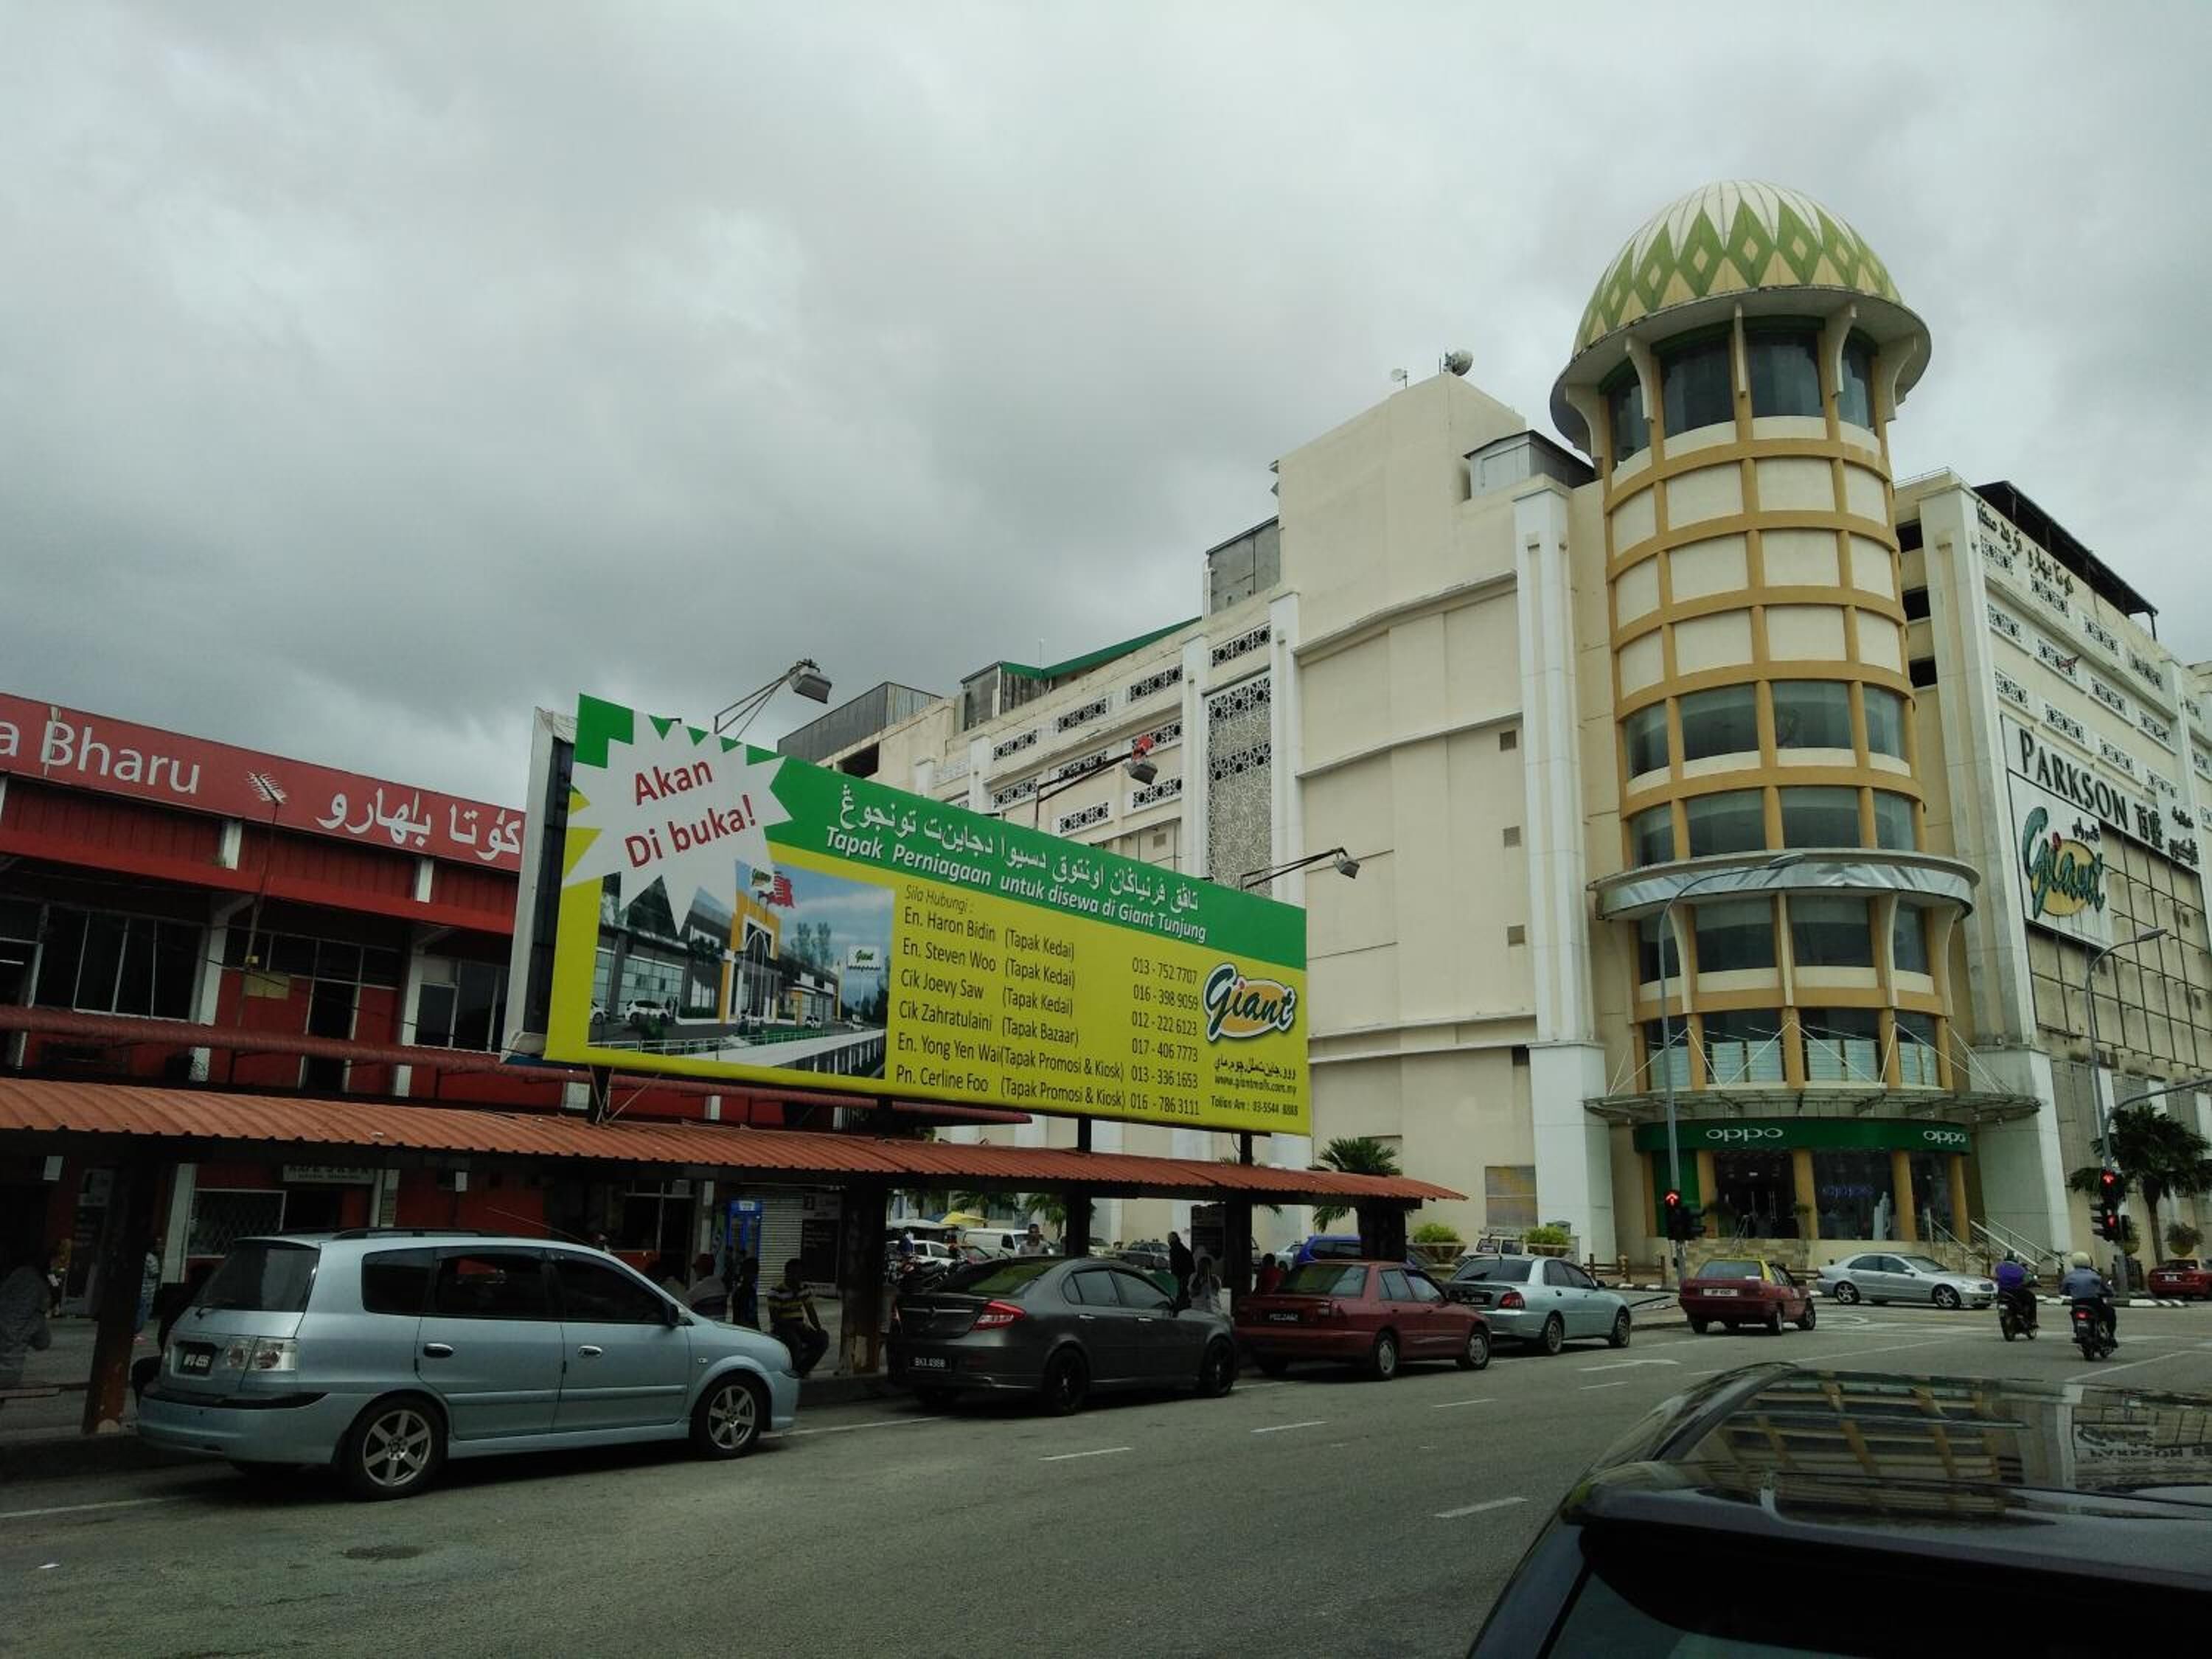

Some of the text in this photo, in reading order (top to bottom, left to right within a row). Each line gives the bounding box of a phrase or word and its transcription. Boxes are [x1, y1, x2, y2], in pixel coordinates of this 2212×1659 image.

[41, 720, 200, 794] Bharu
[636, 761, 713, 806] Akan
[2020, 728, 2128, 831] PARKSON
[625, 794, 756, 868] Di buka!
[2023, 807, 2105, 919] Giant
[827, 826, 1206, 944] Tapak Perniagaan untuk disewa di Giant Tunjung
[905, 884, 924, 902] Sila
[925, 889, 968, 914] Hubungi
[902, 937, 922, 958] En.
[925, 942, 966, 966] Steven
[970, 950, 997, 972] Woo
[1004, 956, 1040, 981] (Tapak
[1043, 964, 1076, 992] Kedai)
[1133, 984, 1151, 1002] 016
[904, 906, 923, 927] En.
[927, 910, 964, 936] Haron
[967, 919, 996, 942] Bidin
[1005, 928, 1040, 952] (Tapak
[1043, 936, 1074, 963] Kedai)
[1132, 956, 1150, 975] 013
[1158, 962, 1175, 980] 752
[899, 1000, 919, 1020] Cik
[921, 1003, 992, 1032] Zahratulaini
[1002, 1016, 1038, 1039] (Tapak
[1040, 1022, 1079, 1048] Bazaar)
[1132, 1037, 1150, 1055] 017
[1157, 1042, 1175, 1060] 406
[1176, 1045, 1198, 1062] 7773
[900, 968, 920, 990] Cik
[923, 973, 958, 1000] Joevy
[960, 979, 984, 1000] Saw
[1002, 986, 1039, 1011] (Tapak
[1040, 994, 1073, 1020] Kedai)
[1132, 1011, 1150, 1029] 012
[1157, 1015, 1175, 1033] 222
[1176, 1018, 1198, 1037] 6123
[1206, 967, 1297, 1037] Giant
[896, 1064, 917, 1085] Pn.
[920, 1066, 964, 1090] Cerline
[967, 1073, 990, 1093] Foo
[1000, 1075, 1037, 1101] (Tapak
[1040, 1081, 1083, 1104] Promosi
[1085, 1086, 1094, 1105] &
[1096, 1088, 1127, 1112] Kiosk)
[1130, 1092, 1149, 1110] 016
[1158, 1096, 1176, 1113] 786
[1178, 1098, 1200, 1116] 3111
[897, 1032, 917, 1053] En.
[921, 1034, 951, 1061] Yong
[953, 1039, 975, 1060] Yen
[1039, 1051, 1082, 1074] Promosi
[1084, 1057, 1093, 1075] &
[1095, 1060, 1124, 1083] Kiosk)
[1131, 1065, 1150, 1083] 013
